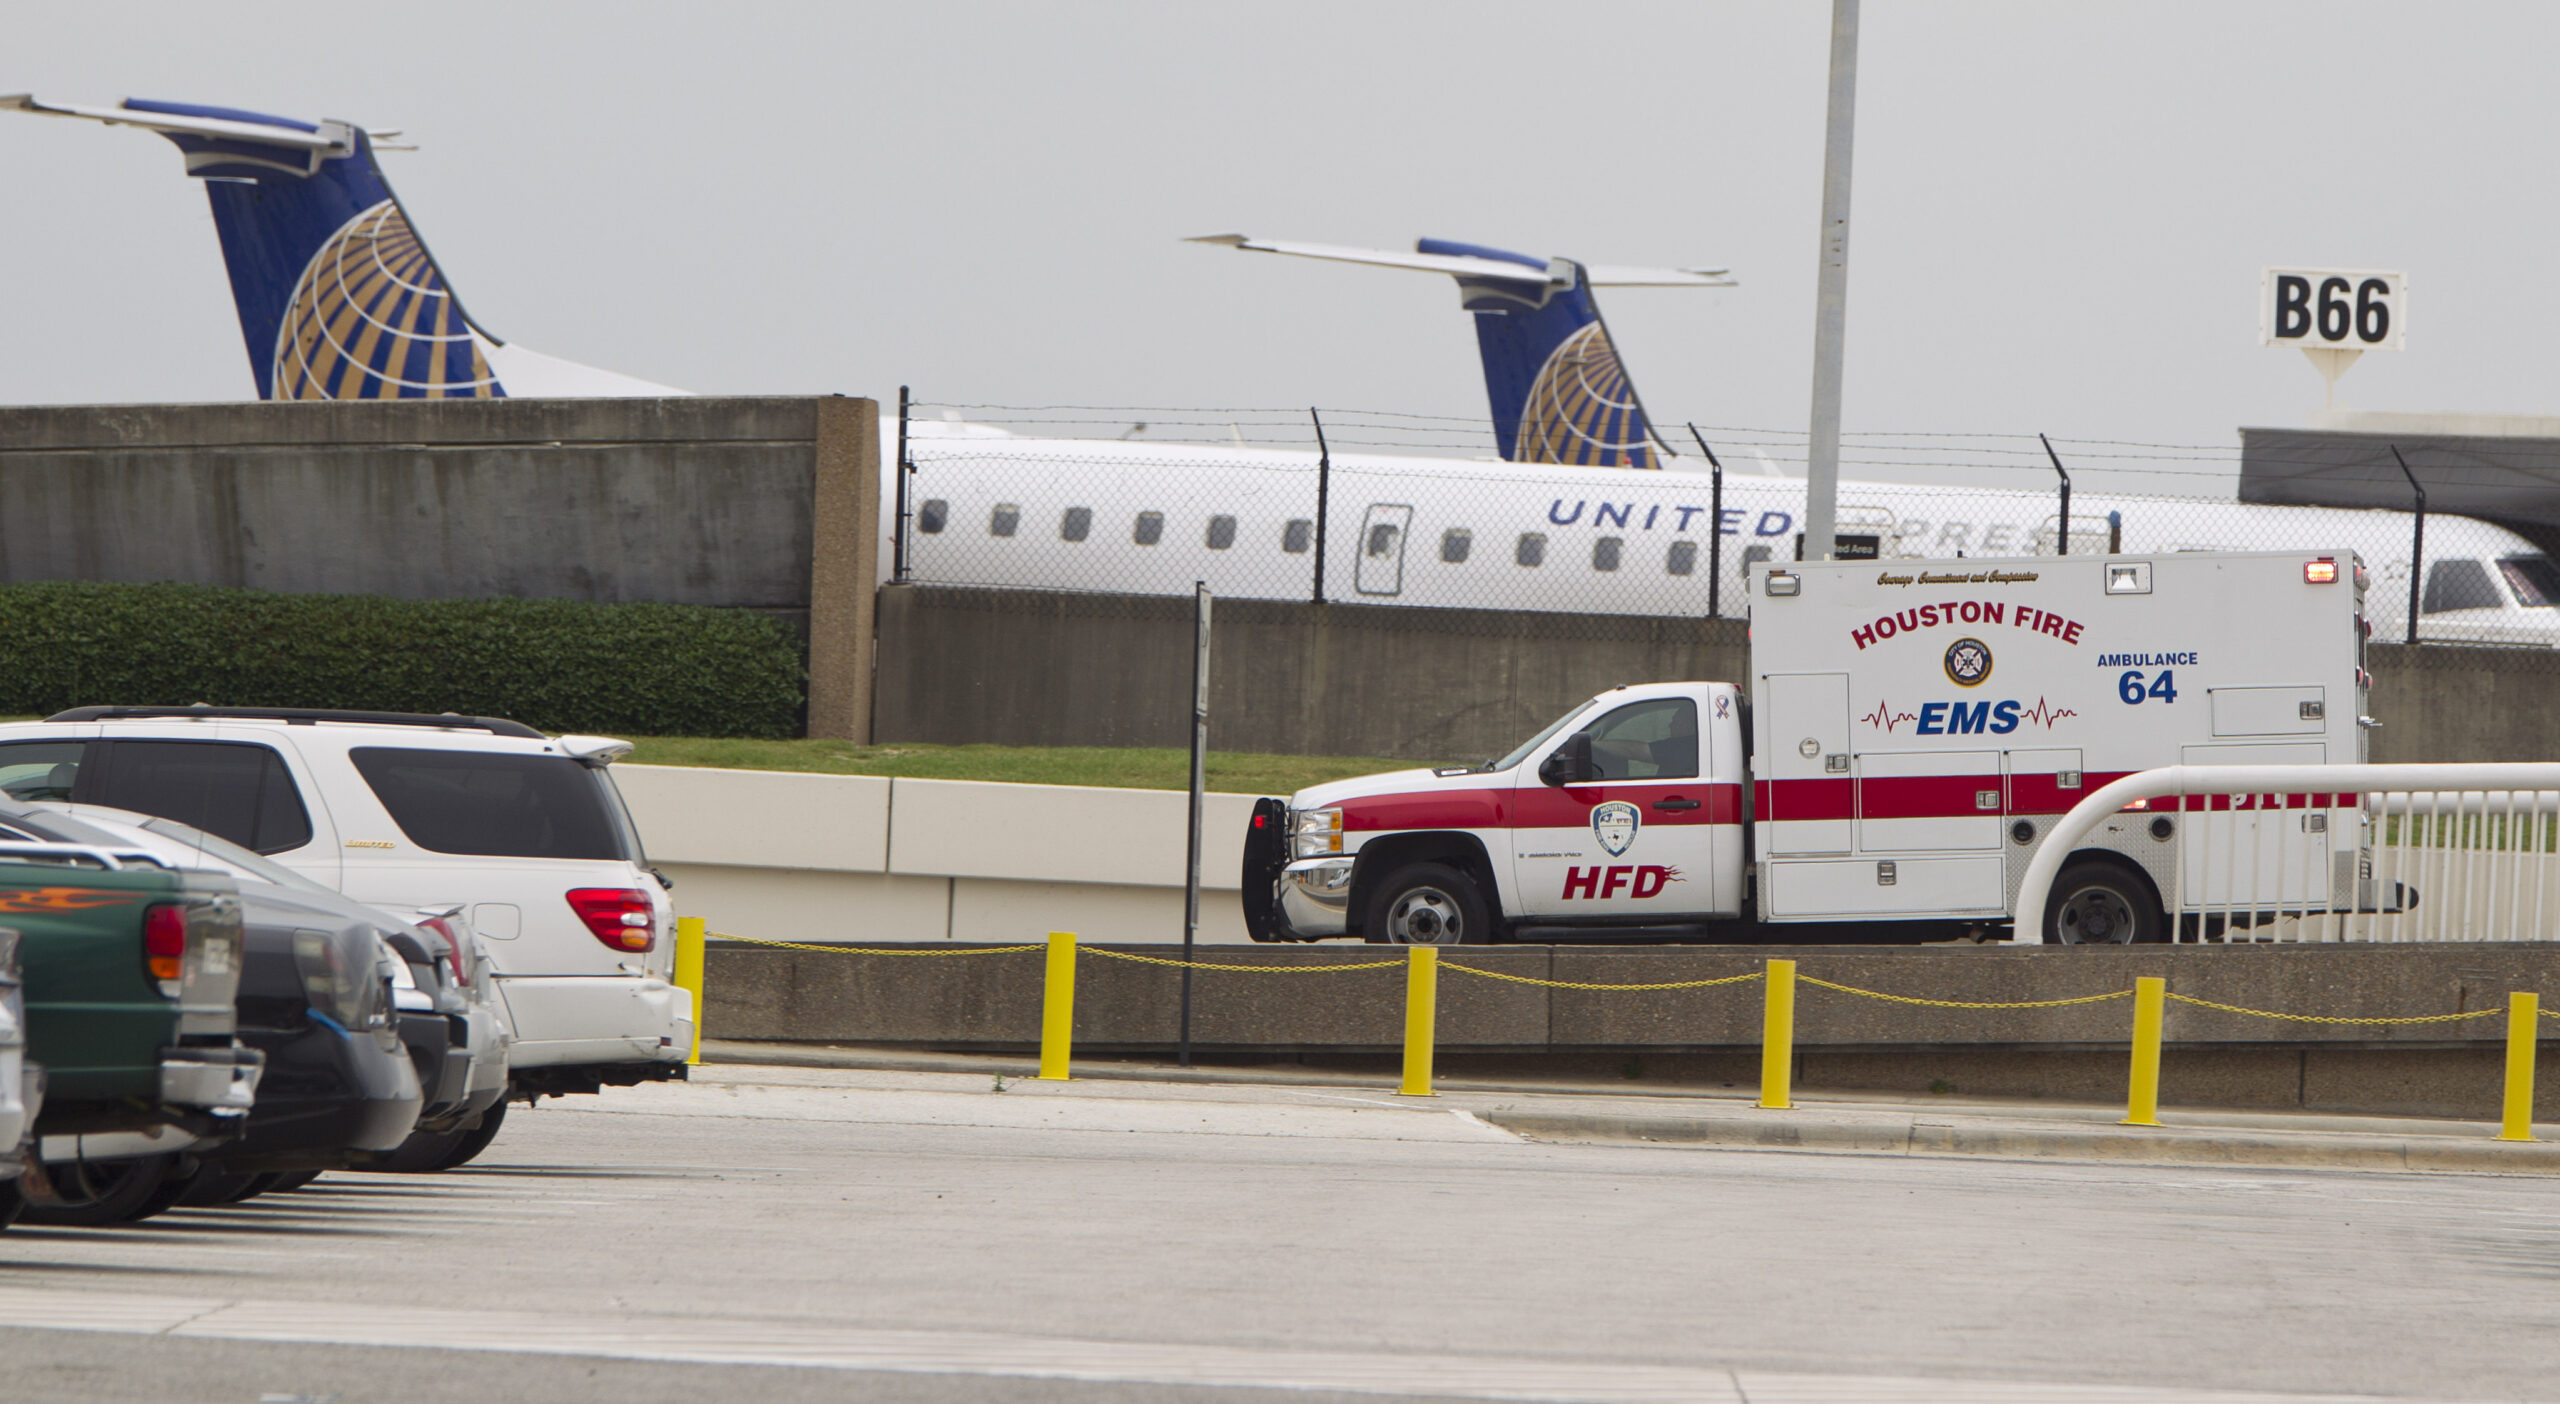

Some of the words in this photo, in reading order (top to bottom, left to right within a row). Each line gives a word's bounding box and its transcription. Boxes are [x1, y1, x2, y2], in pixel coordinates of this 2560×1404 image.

[2274, 274, 2391, 343] B66
[1549, 499, 1793, 537] UNITED
[1851, 543, 1874, 554] Area
[1851, 600, 2005, 651] HOUSTON
[2014, 604, 2085, 646] FIRE
[2097, 651, 2199, 668] AMBULANCE
[2118, 669, 2178, 706] 64
[1915, 699, 2022, 736] EMS
[1600, 803, 1632, 815] HOUSTON
[1561, 865, 1687, 900] HFD
